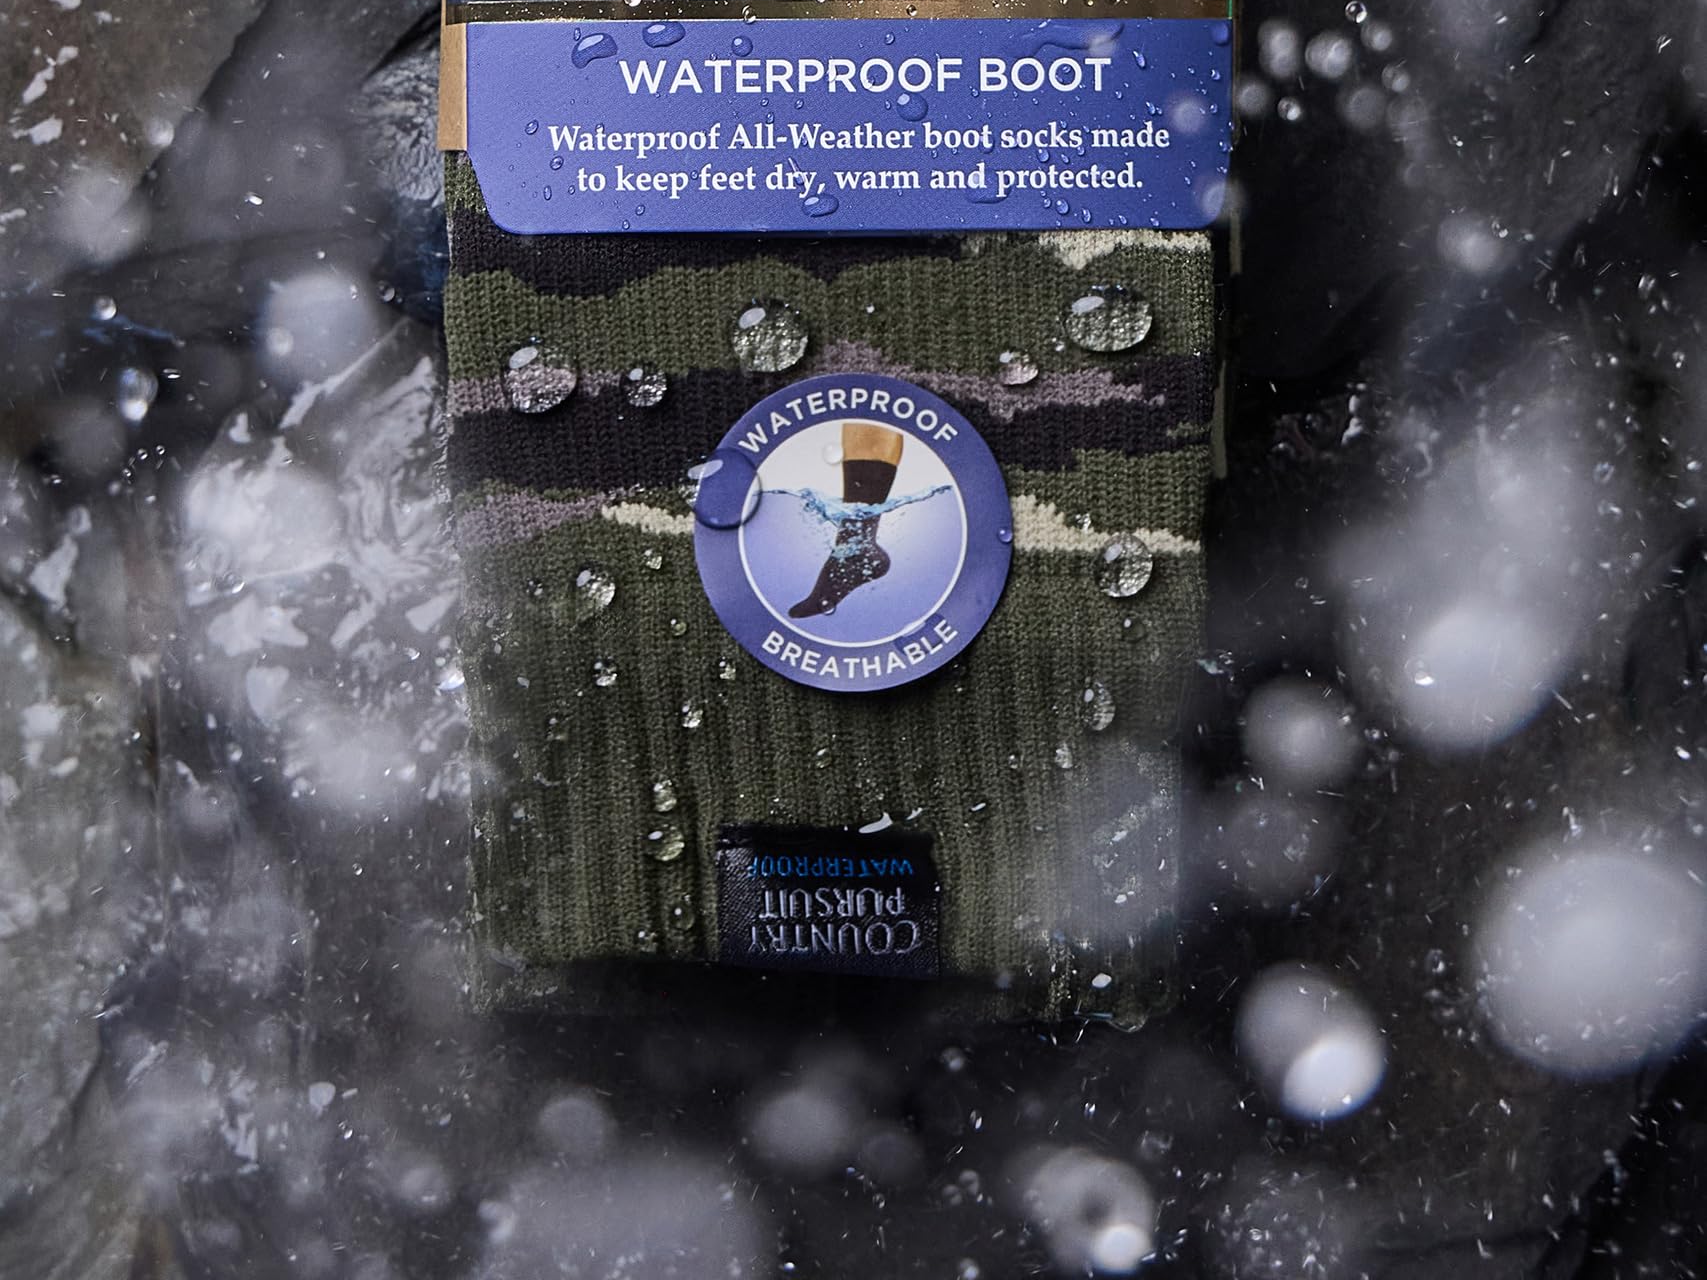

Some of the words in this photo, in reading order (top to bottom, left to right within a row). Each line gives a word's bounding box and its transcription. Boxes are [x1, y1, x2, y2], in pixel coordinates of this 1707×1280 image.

[618, 57, 963, 94] WATERPROOF
[979, 57, 1112, 92] BOOT
[547, 123, 721, 159] Waterproof
[728, 121, 916, 150] All-Weather
[922, 121, 993, 149] boot
[1000, 121, 1083, 149] socks
[1090, 120, 1170, 149] made
[577, 167, 606, 192] to
[614, 165, 689, 199] keep
[698, 163, 757, 191] feet
[765, 162, 826, 199] dry,
[833, 169, 921, 191] warm
[929, 162, 987, 190] and
[995, 161, 1144, 198] protected.
[738, 387, 959, 455] WATERPROOF
[761, 618, 959, 679] BREATHABLE
[747, 855, 914, 878] WATERPROOF
[758, 886, 906, 919] PURSUIT
[748, 919, 921, 956] COUNTRY
